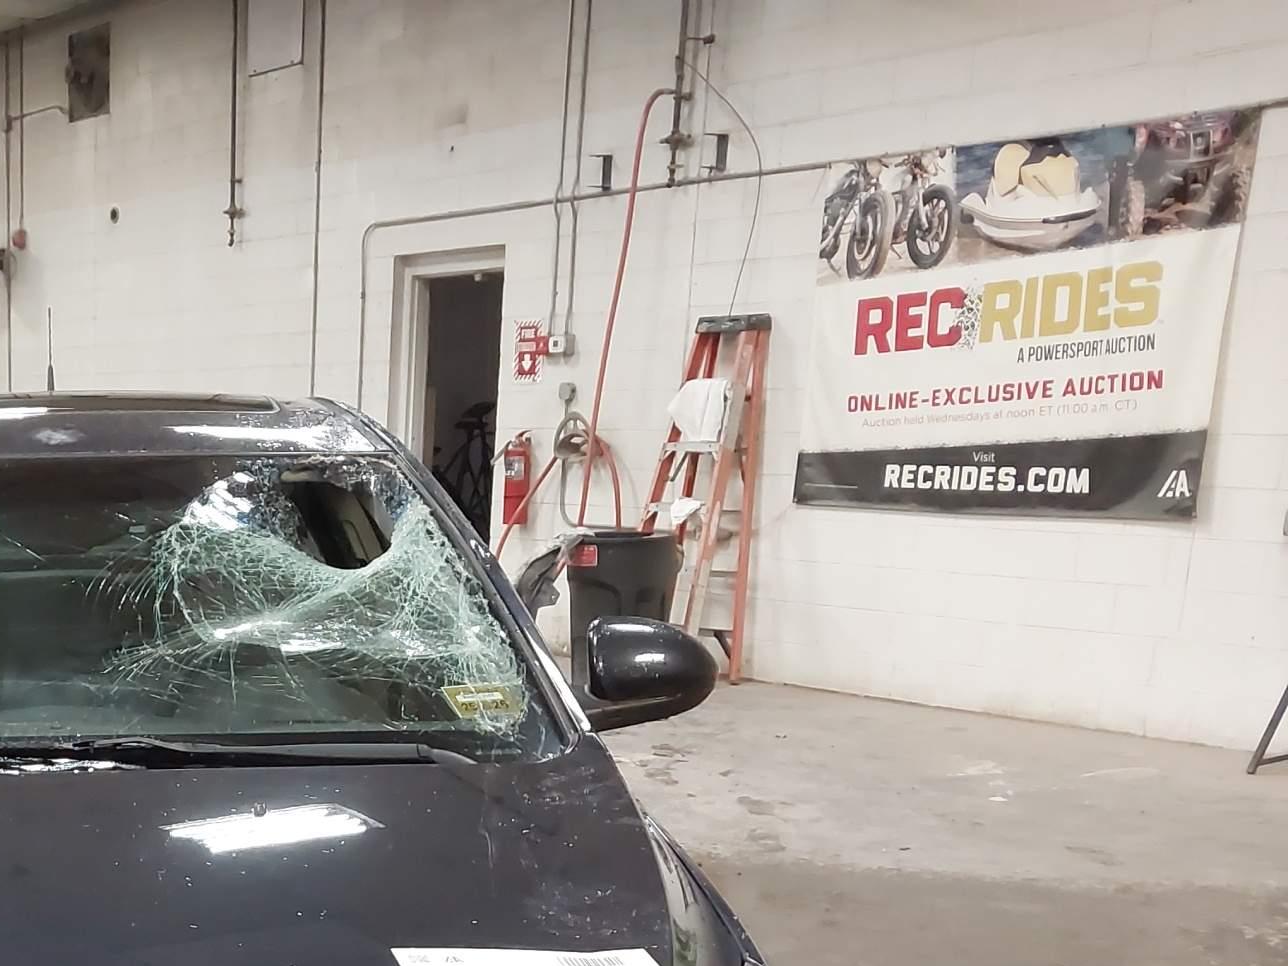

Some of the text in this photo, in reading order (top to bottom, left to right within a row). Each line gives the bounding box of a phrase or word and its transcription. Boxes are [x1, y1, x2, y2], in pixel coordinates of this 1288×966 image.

[854, 260, 1163, 355] REC RIDES
[1016, 333, 1156, 363] A POWERSPORT AUCTION
[847, 369, 1164, 413] ONLINE-EXCLUSIVE AUCTION
[862, 415, 902, 428] Auction
[903, 414, 924, 426] held
[926, 410, 991, 425] Wednesdays
[993, 410, 1003, 420] at
[1006, 408, 1035, 419] noon
[1039, 405, 1054, 417] ET
[972, 451, 996, 463] Visit
[883, 463, 1090, 494] RECRIDES.COM
